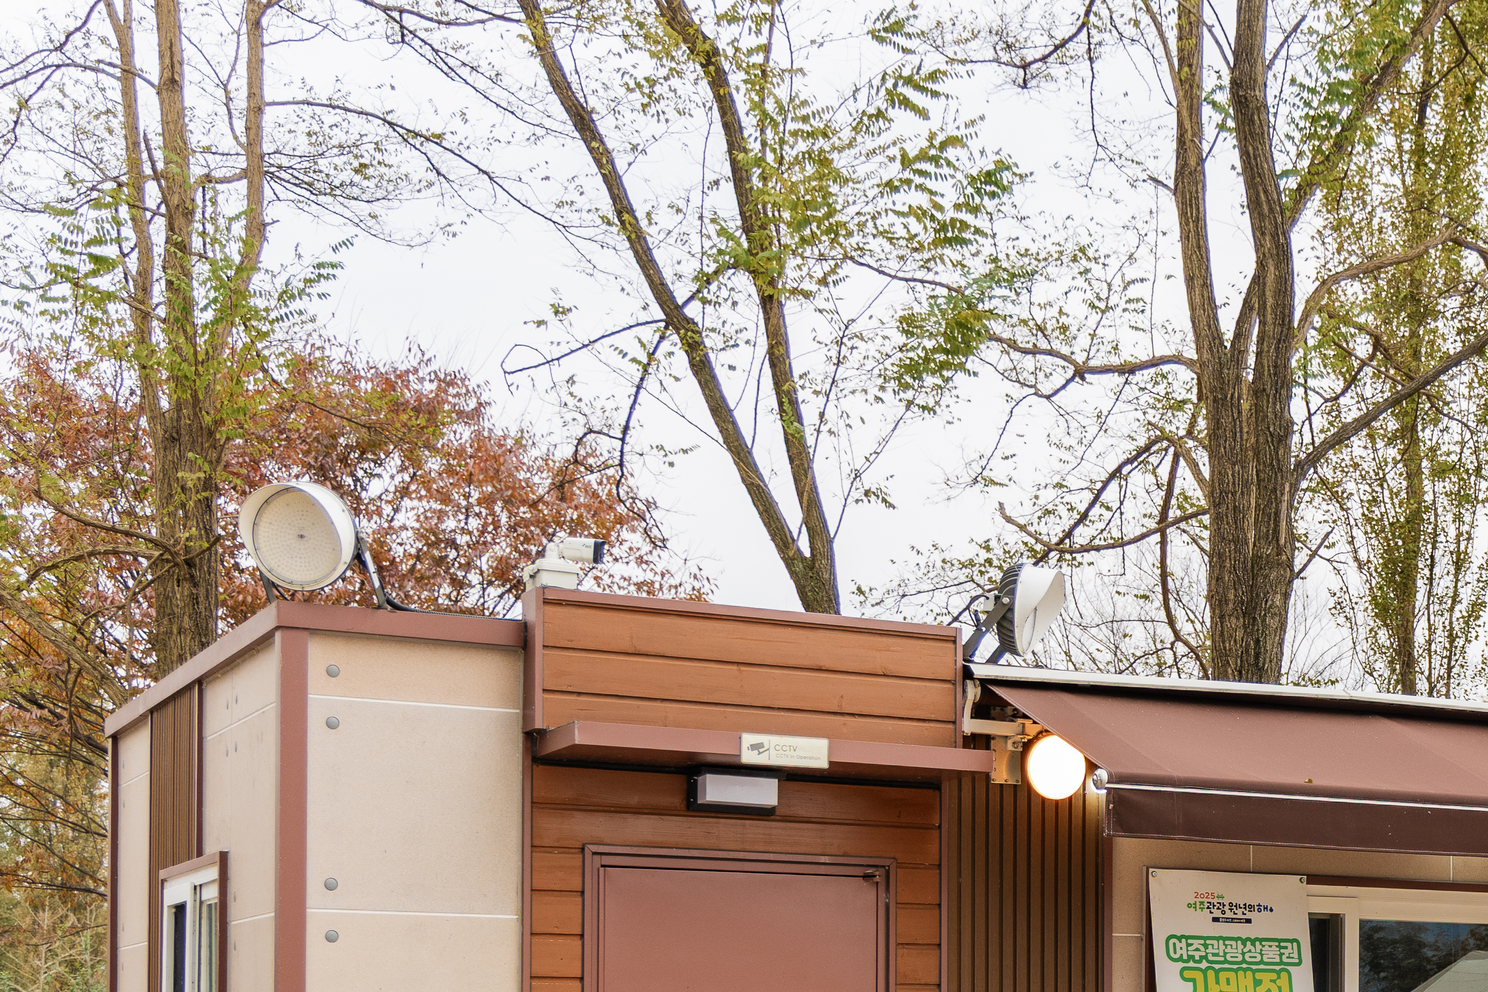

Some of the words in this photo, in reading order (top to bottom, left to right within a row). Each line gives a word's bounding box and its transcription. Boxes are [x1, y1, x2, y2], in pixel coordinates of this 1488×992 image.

[774, 744, 798, 753] CCTV
[1194, 891, 1216, 900] 2025
[1168, 936, 1300, 964] 여주관광상품권
